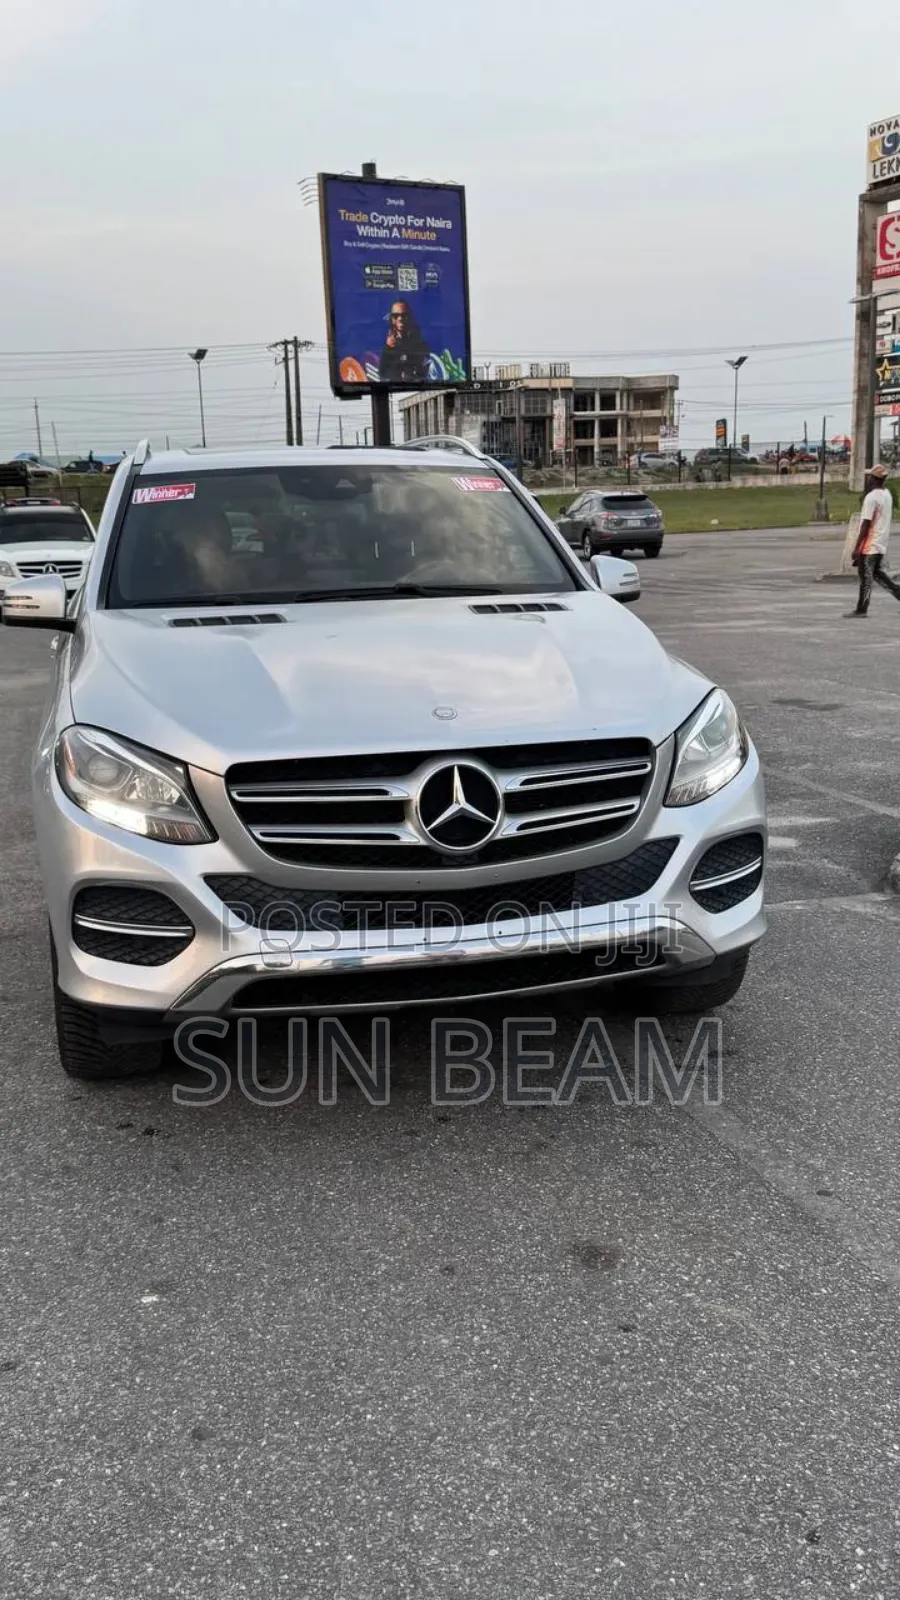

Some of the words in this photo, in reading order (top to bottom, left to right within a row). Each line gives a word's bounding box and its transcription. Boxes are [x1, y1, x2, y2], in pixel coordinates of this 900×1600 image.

[339, 210, 368, 222] Trade
[369, 212, 405, 226] Crypto
[407, 215, 424, 227] For
[426, 217, 452, 229] Naira
[356, 225, 389, 238] Within
[391, 227, 400, 238] A
[402, 229, 436, 240] Minute
[135, 487, 182, 503] Winner
